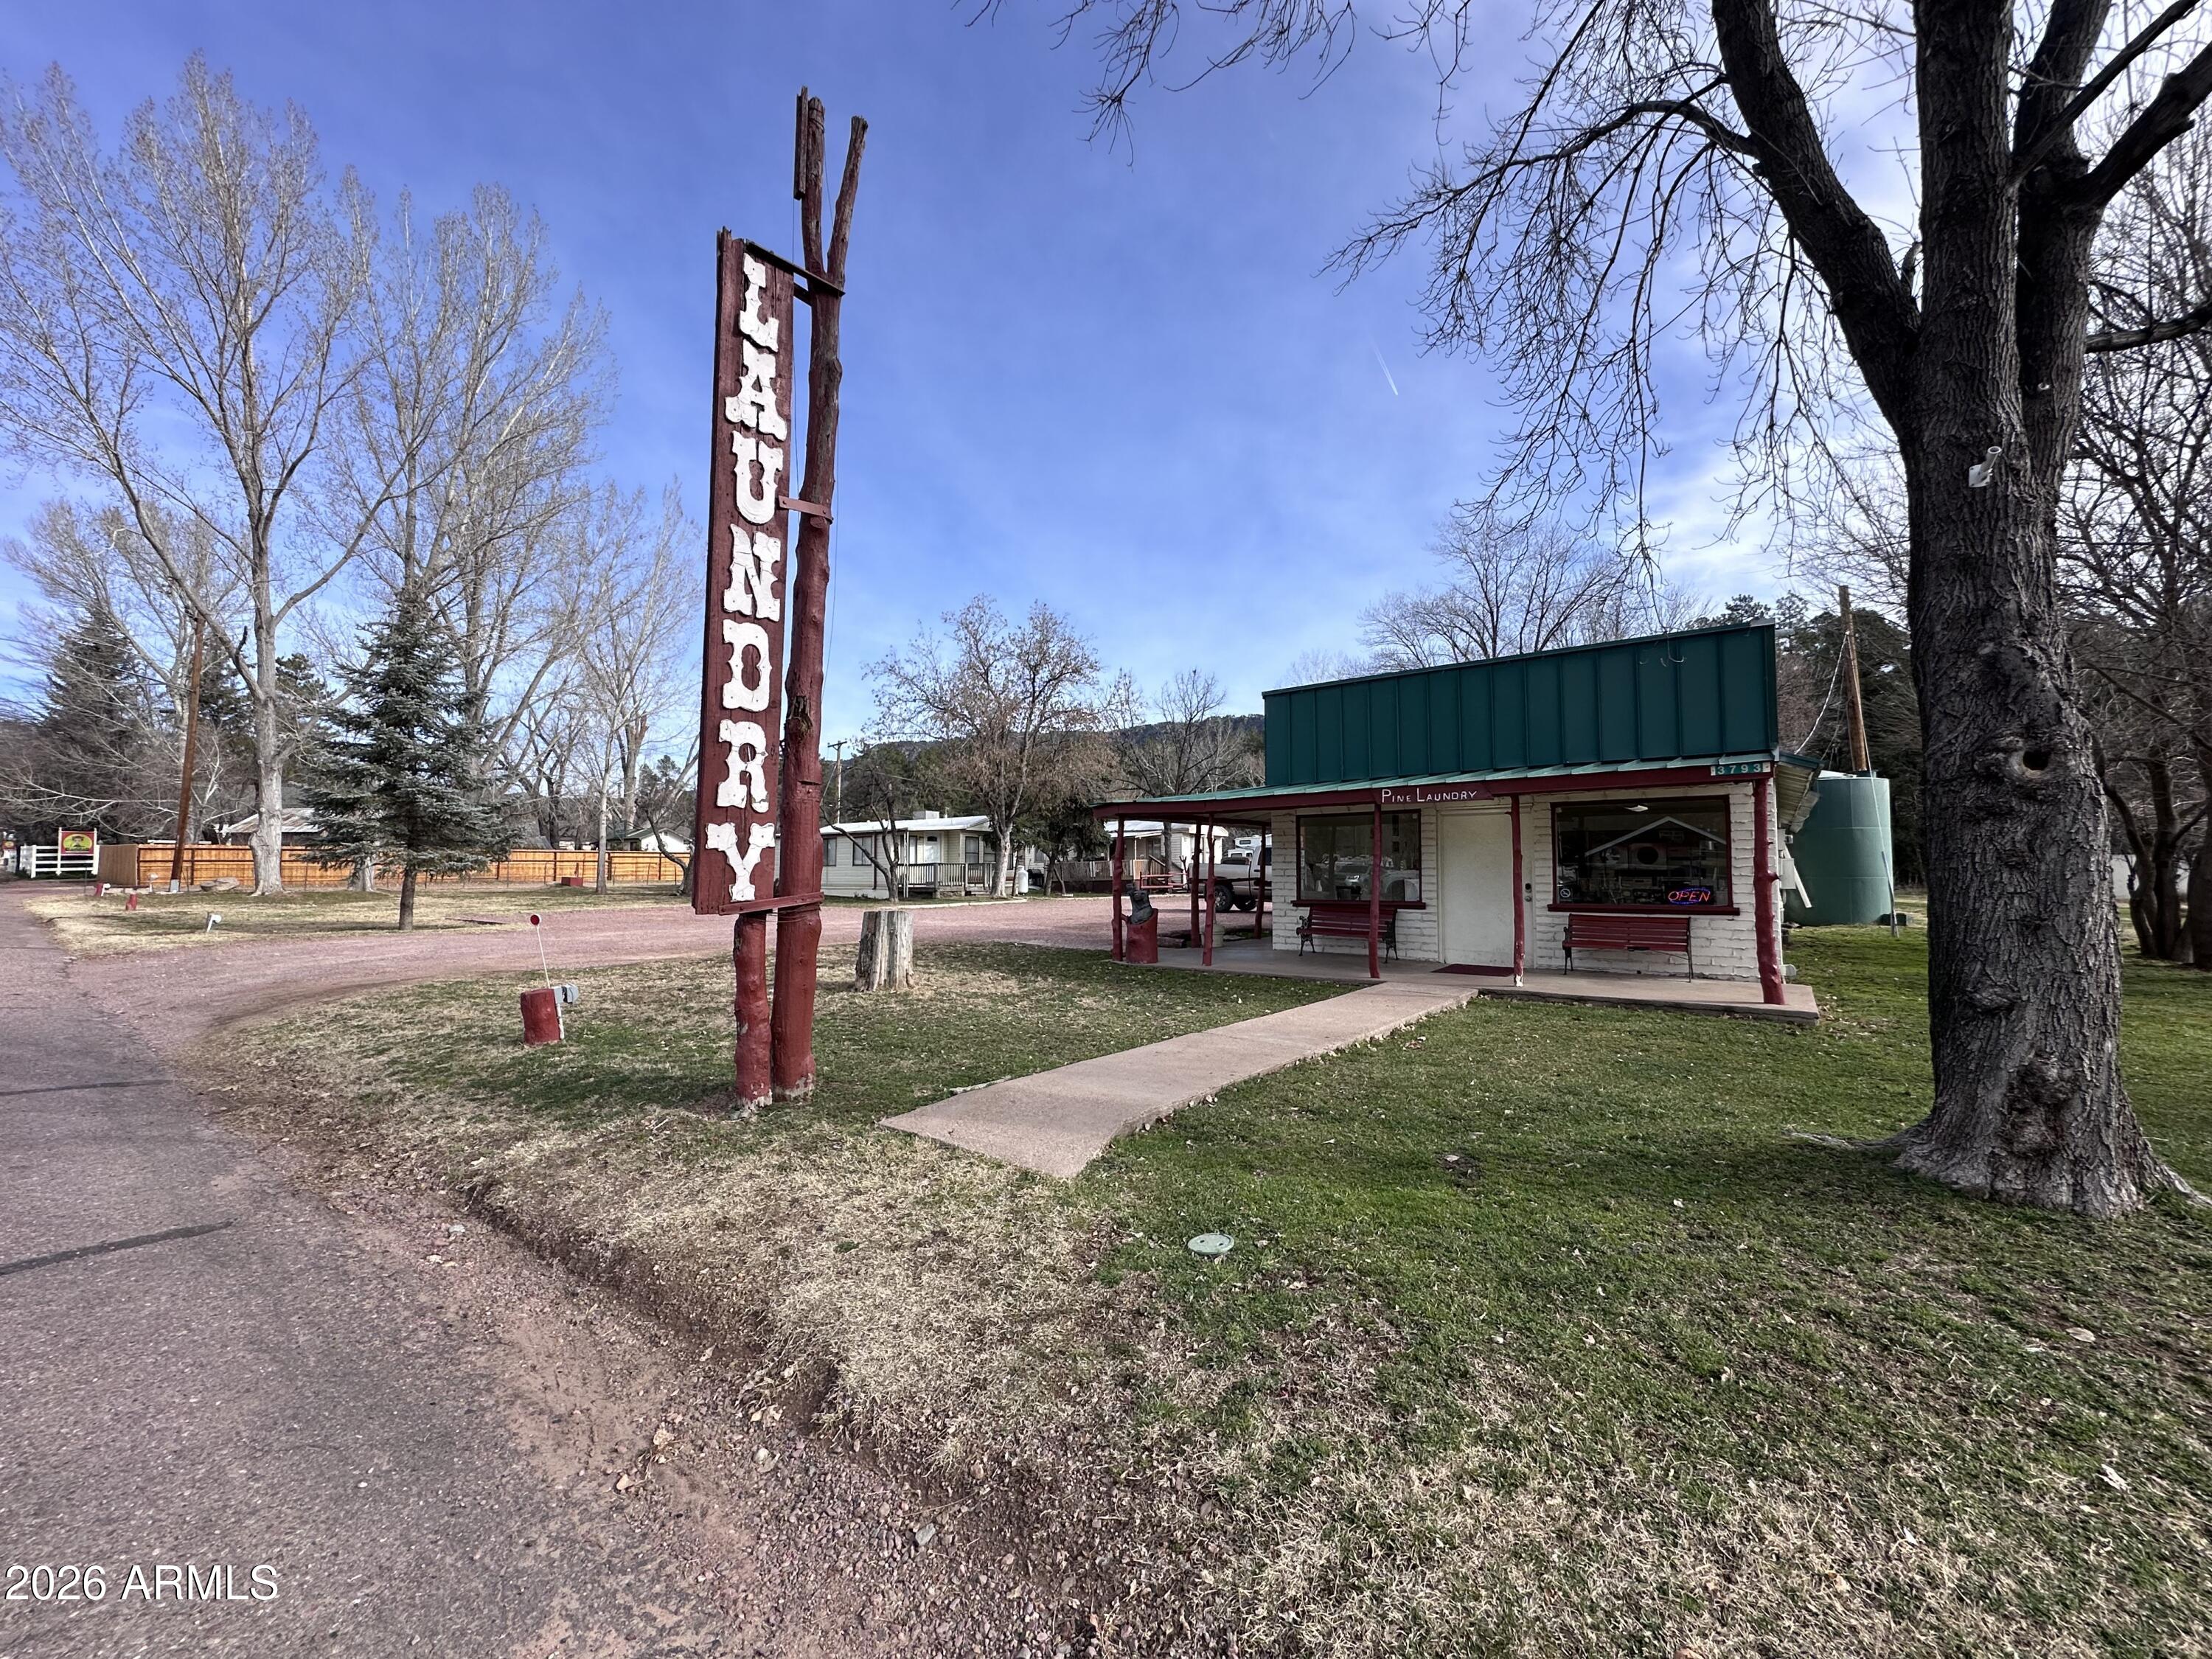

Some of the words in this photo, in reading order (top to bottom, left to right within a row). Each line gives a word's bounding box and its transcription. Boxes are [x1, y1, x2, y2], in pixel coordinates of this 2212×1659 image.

[705, 254, 787, 902] LAUNDRY
[1717, 763, 1761, 775] 3793
[1382, 788, 1411, 803] PINE
[1416, 787, 1477, 802] LAUNDRY
[1668, 890, 1711, 902] OPEN
